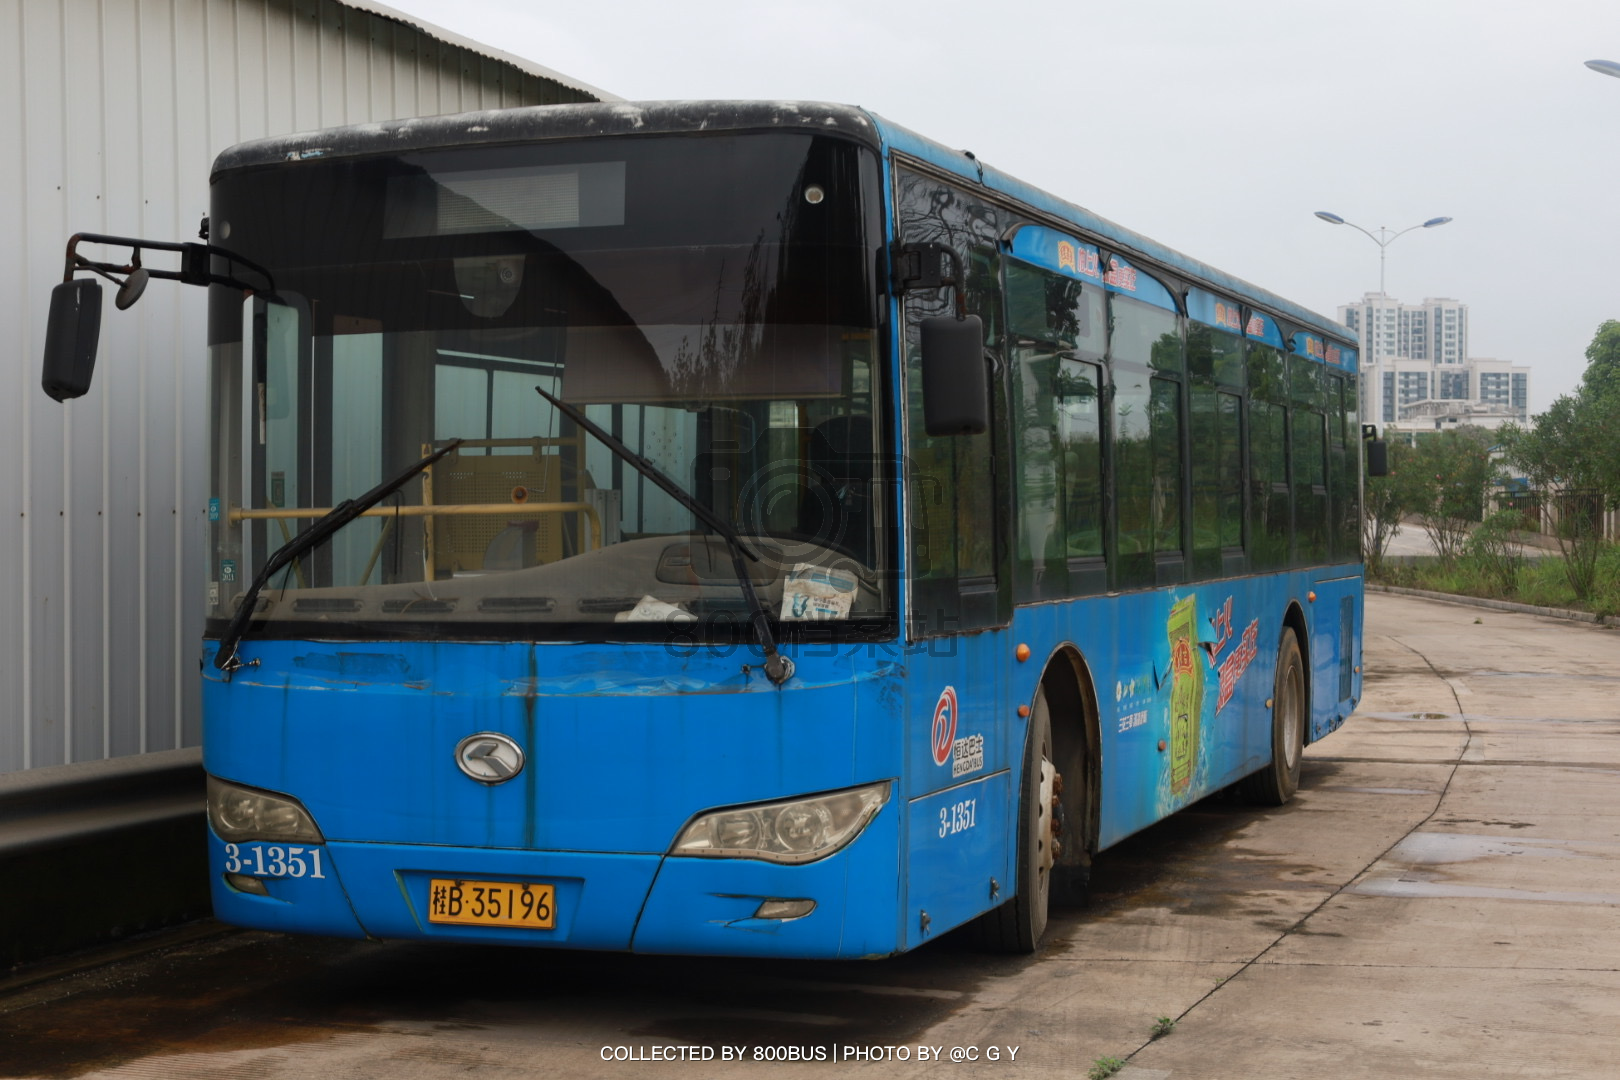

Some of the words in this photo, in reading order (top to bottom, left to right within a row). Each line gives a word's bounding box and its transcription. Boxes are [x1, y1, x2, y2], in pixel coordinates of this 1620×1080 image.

[953, 733, 983, 760] 恒达巴士
[939, 798, 977, 839] 3-1351
[225, 843, 326, 879] 3-1351
